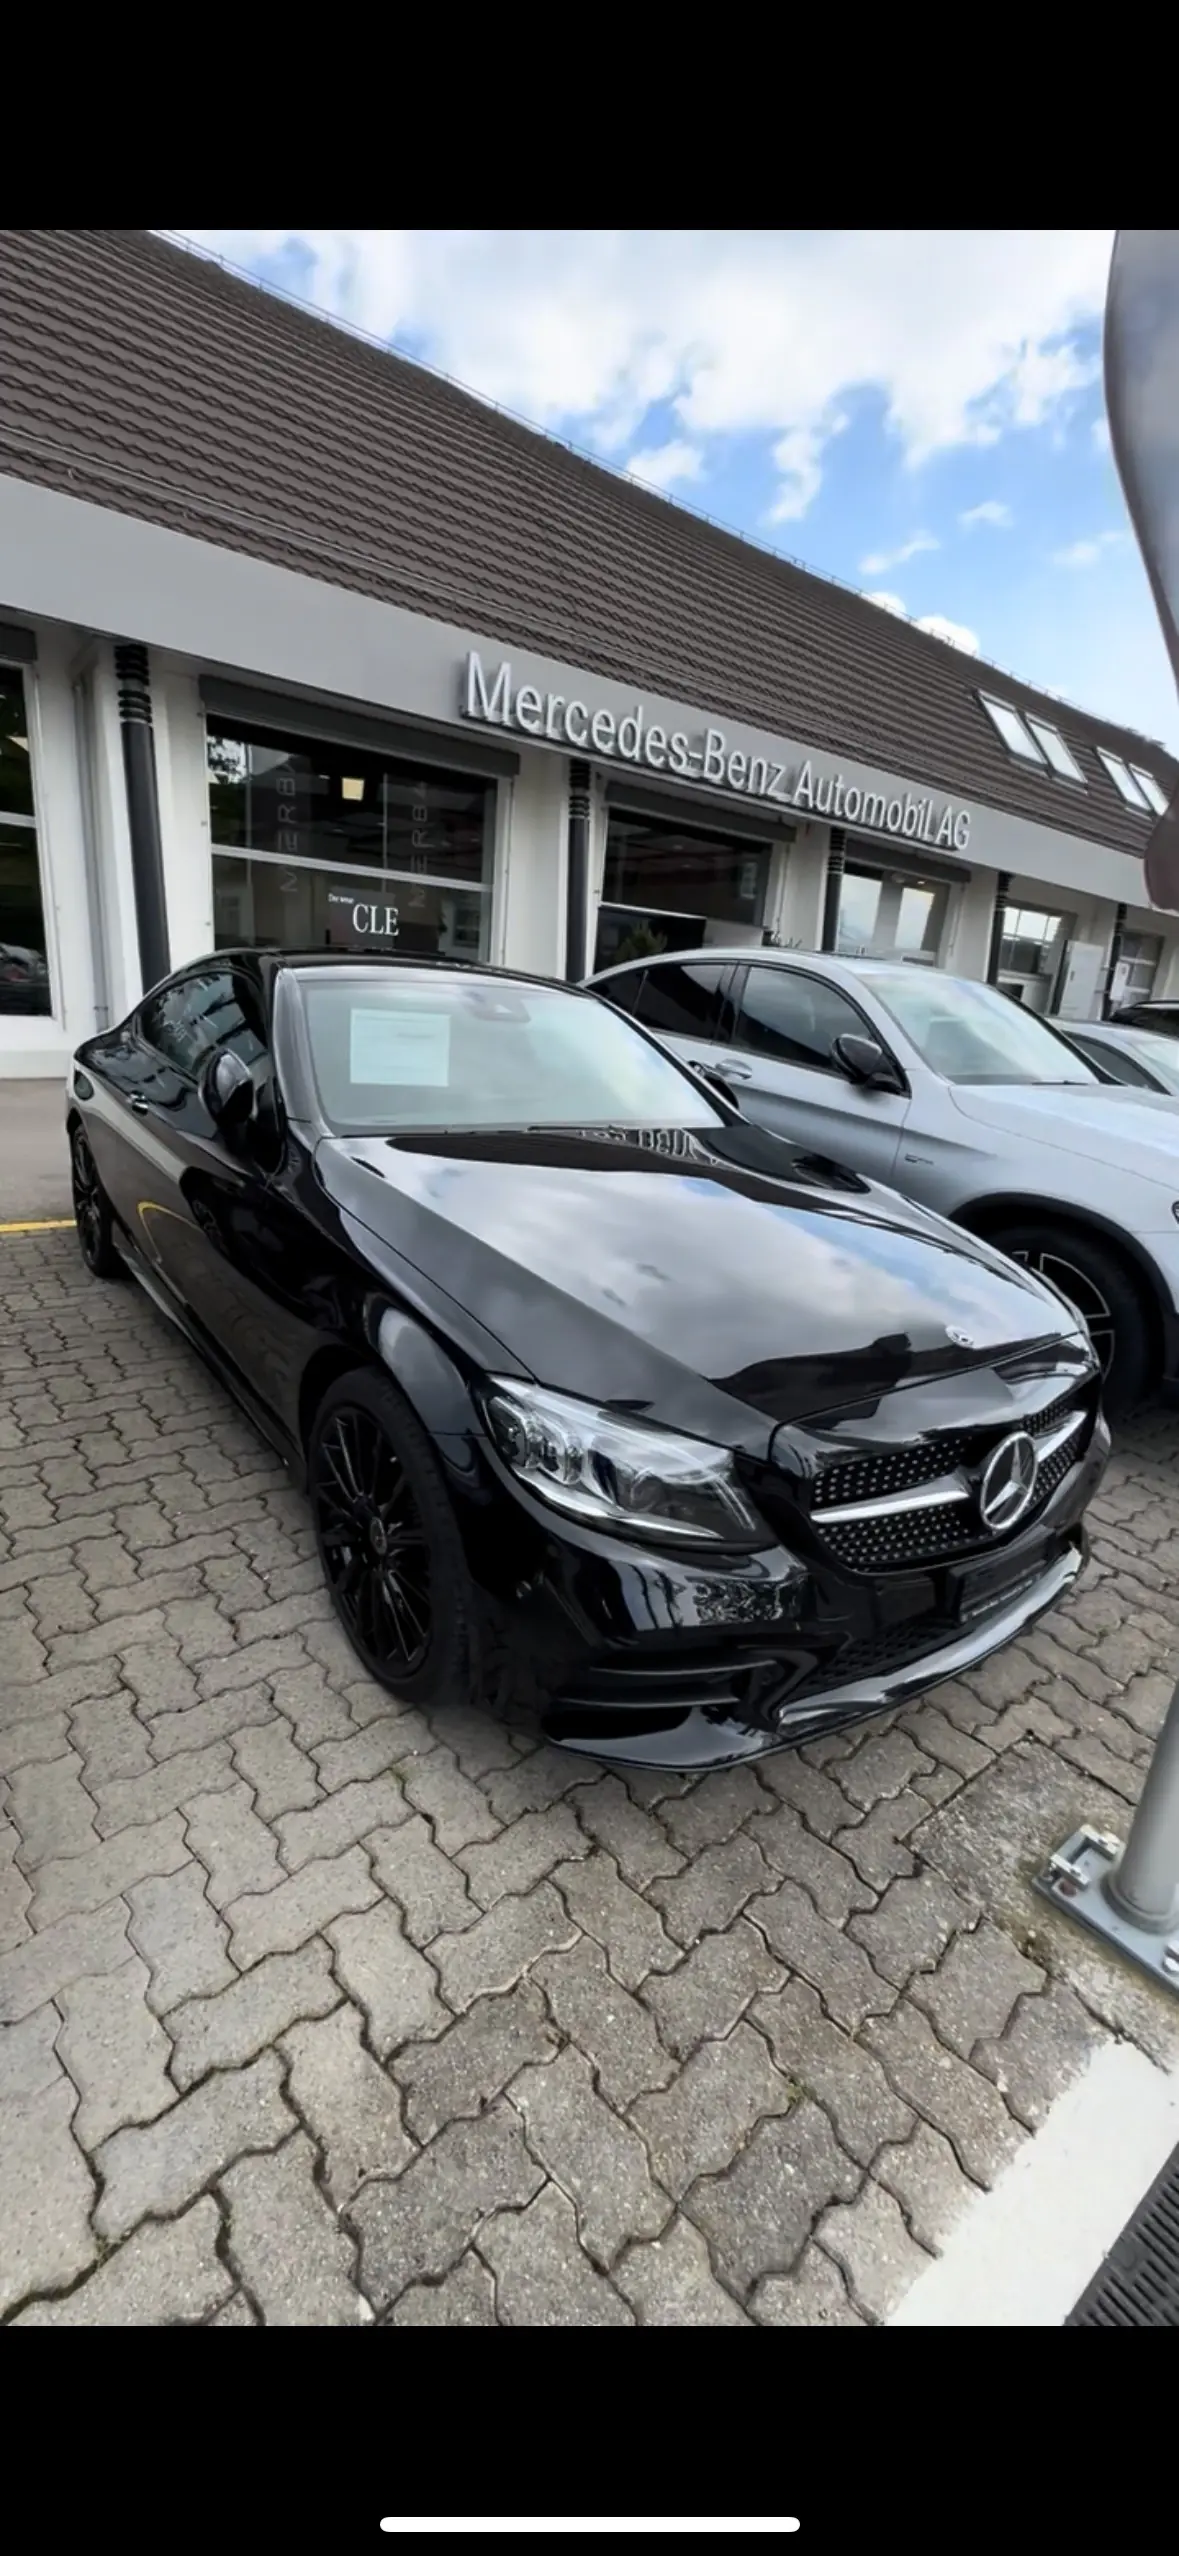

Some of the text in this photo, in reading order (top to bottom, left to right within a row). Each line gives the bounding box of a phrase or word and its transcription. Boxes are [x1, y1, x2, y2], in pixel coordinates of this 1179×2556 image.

[465, 650, 970, 850] Mercedes-Benz Automobil AG
[352, 903, 400, 936] CLE
